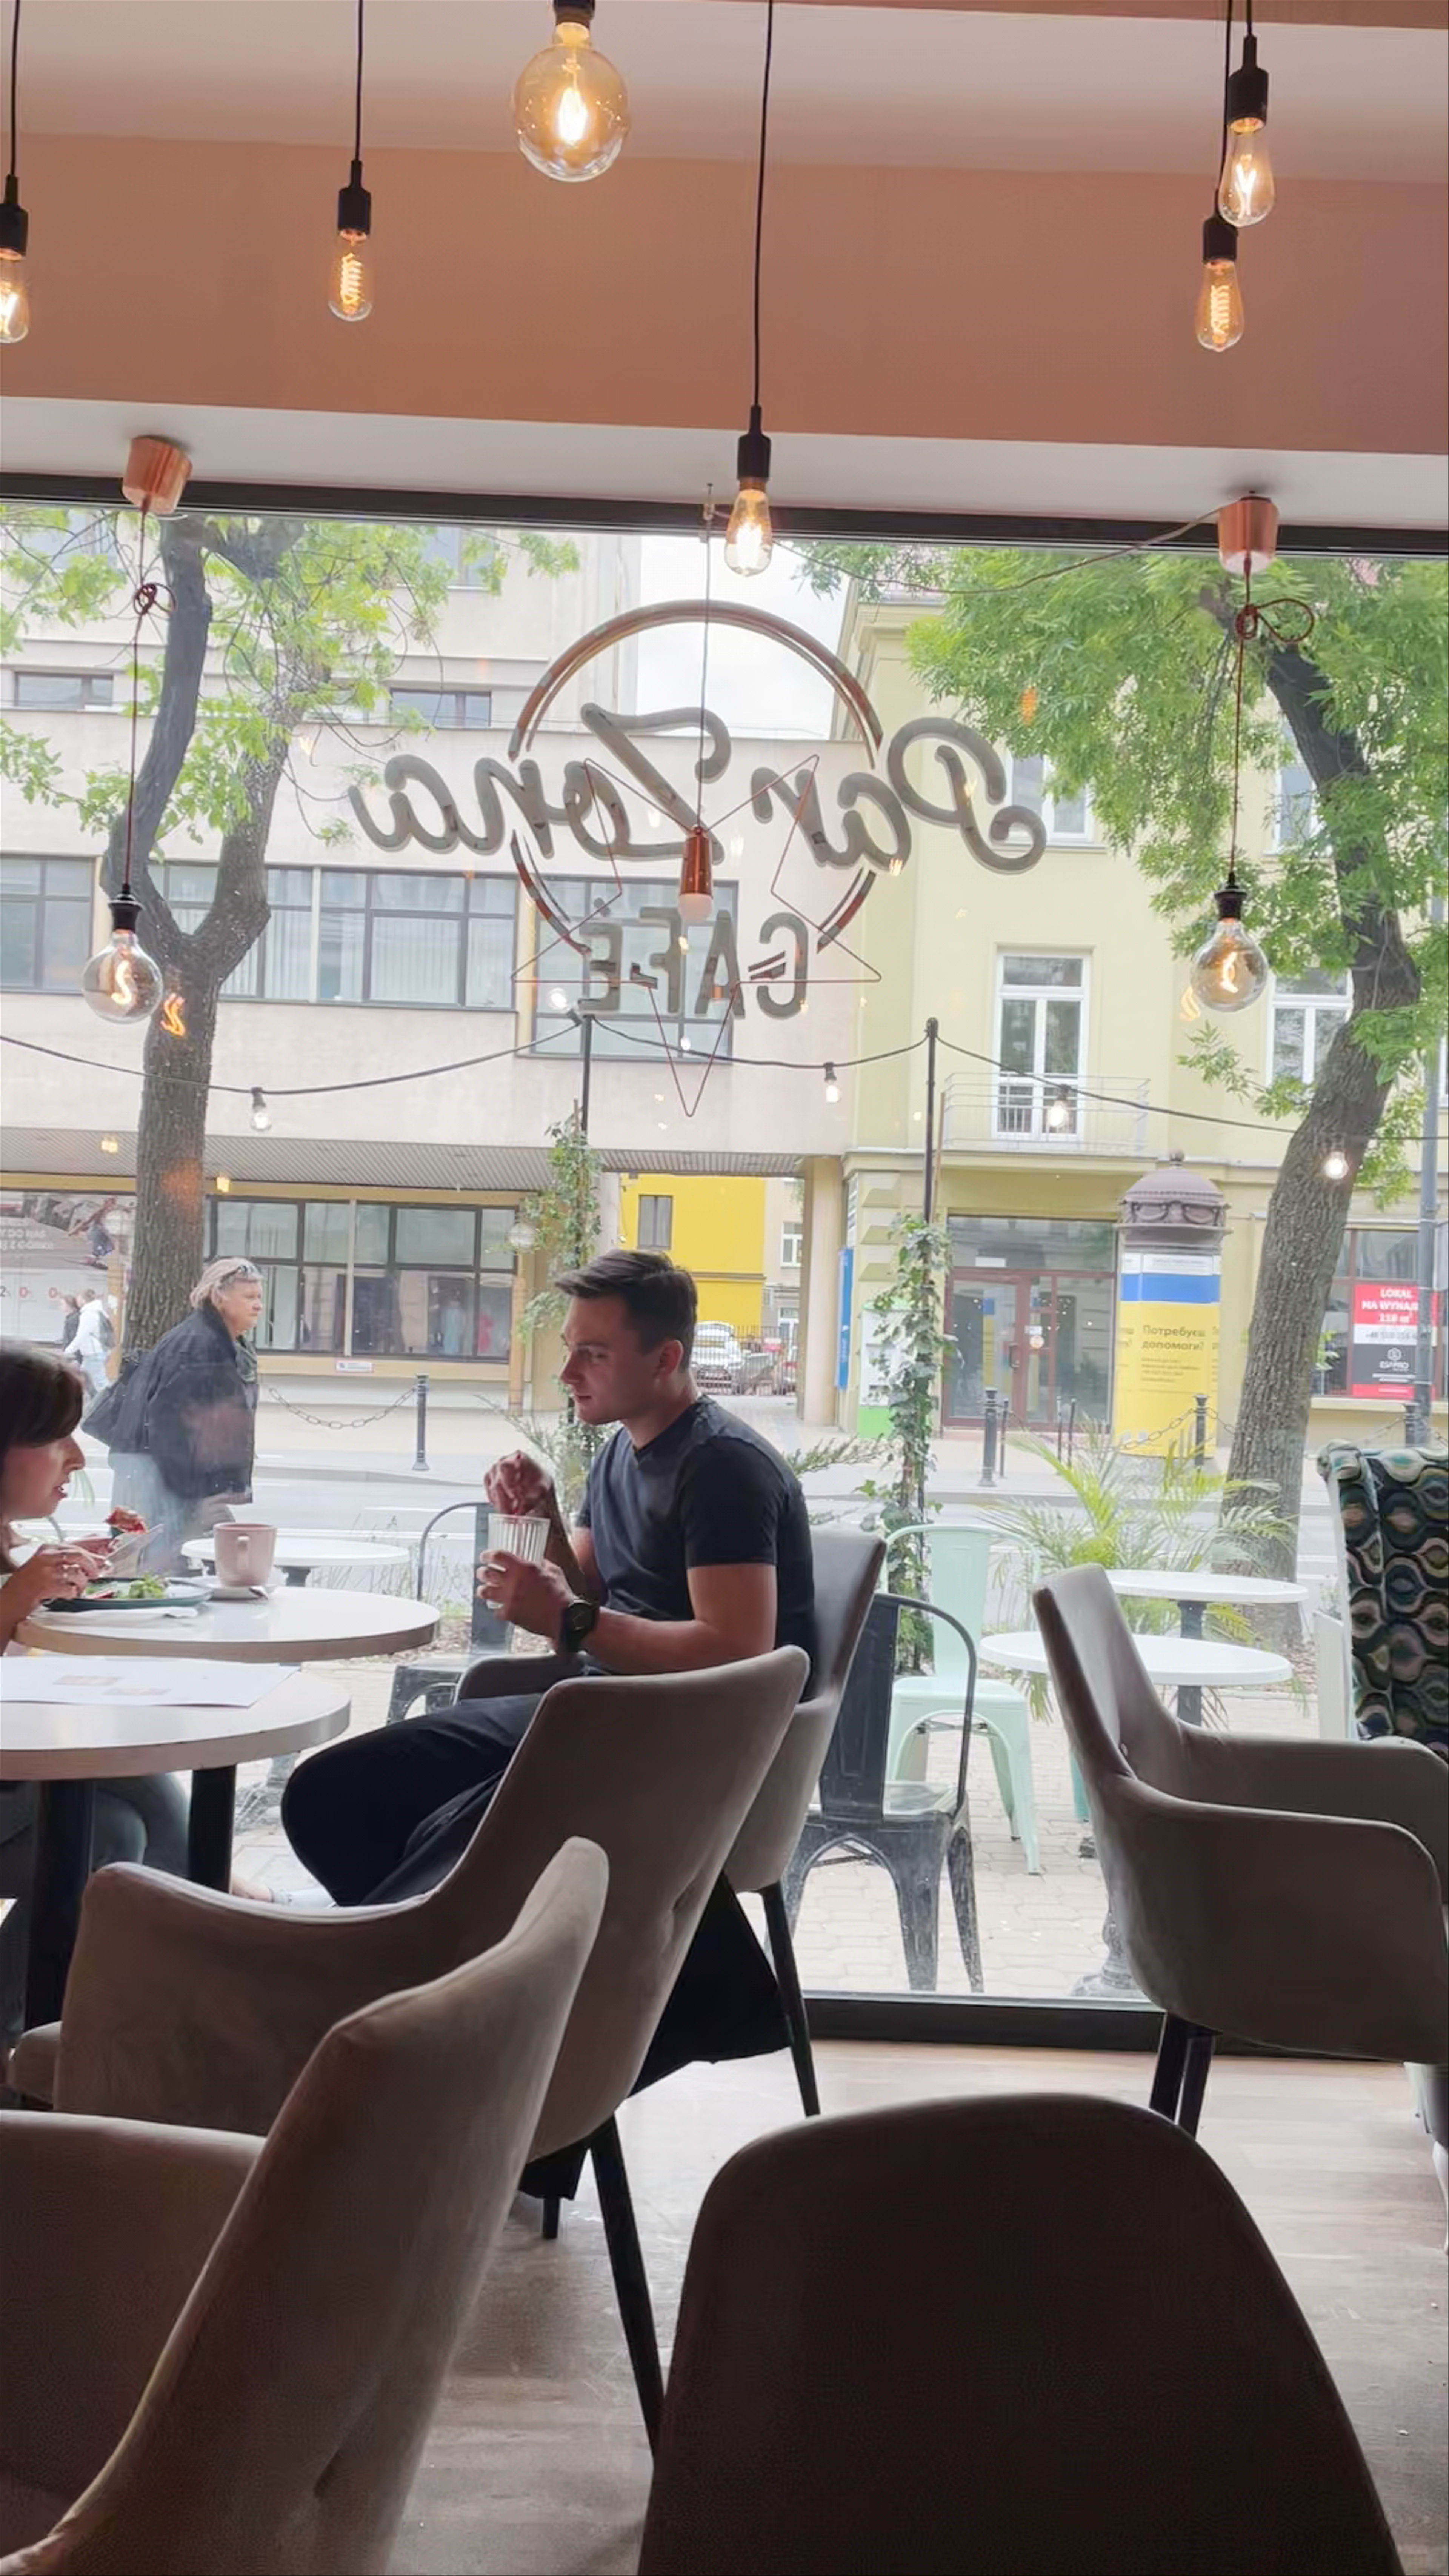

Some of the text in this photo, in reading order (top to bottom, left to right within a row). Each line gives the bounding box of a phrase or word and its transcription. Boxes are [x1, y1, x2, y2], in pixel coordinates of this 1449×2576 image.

[1380, 1288, 1414, 1299] LOKAL
[1362, 1300, 1377, 1310] NA
[1141, 1341, 1204, 1351] допомоги?
